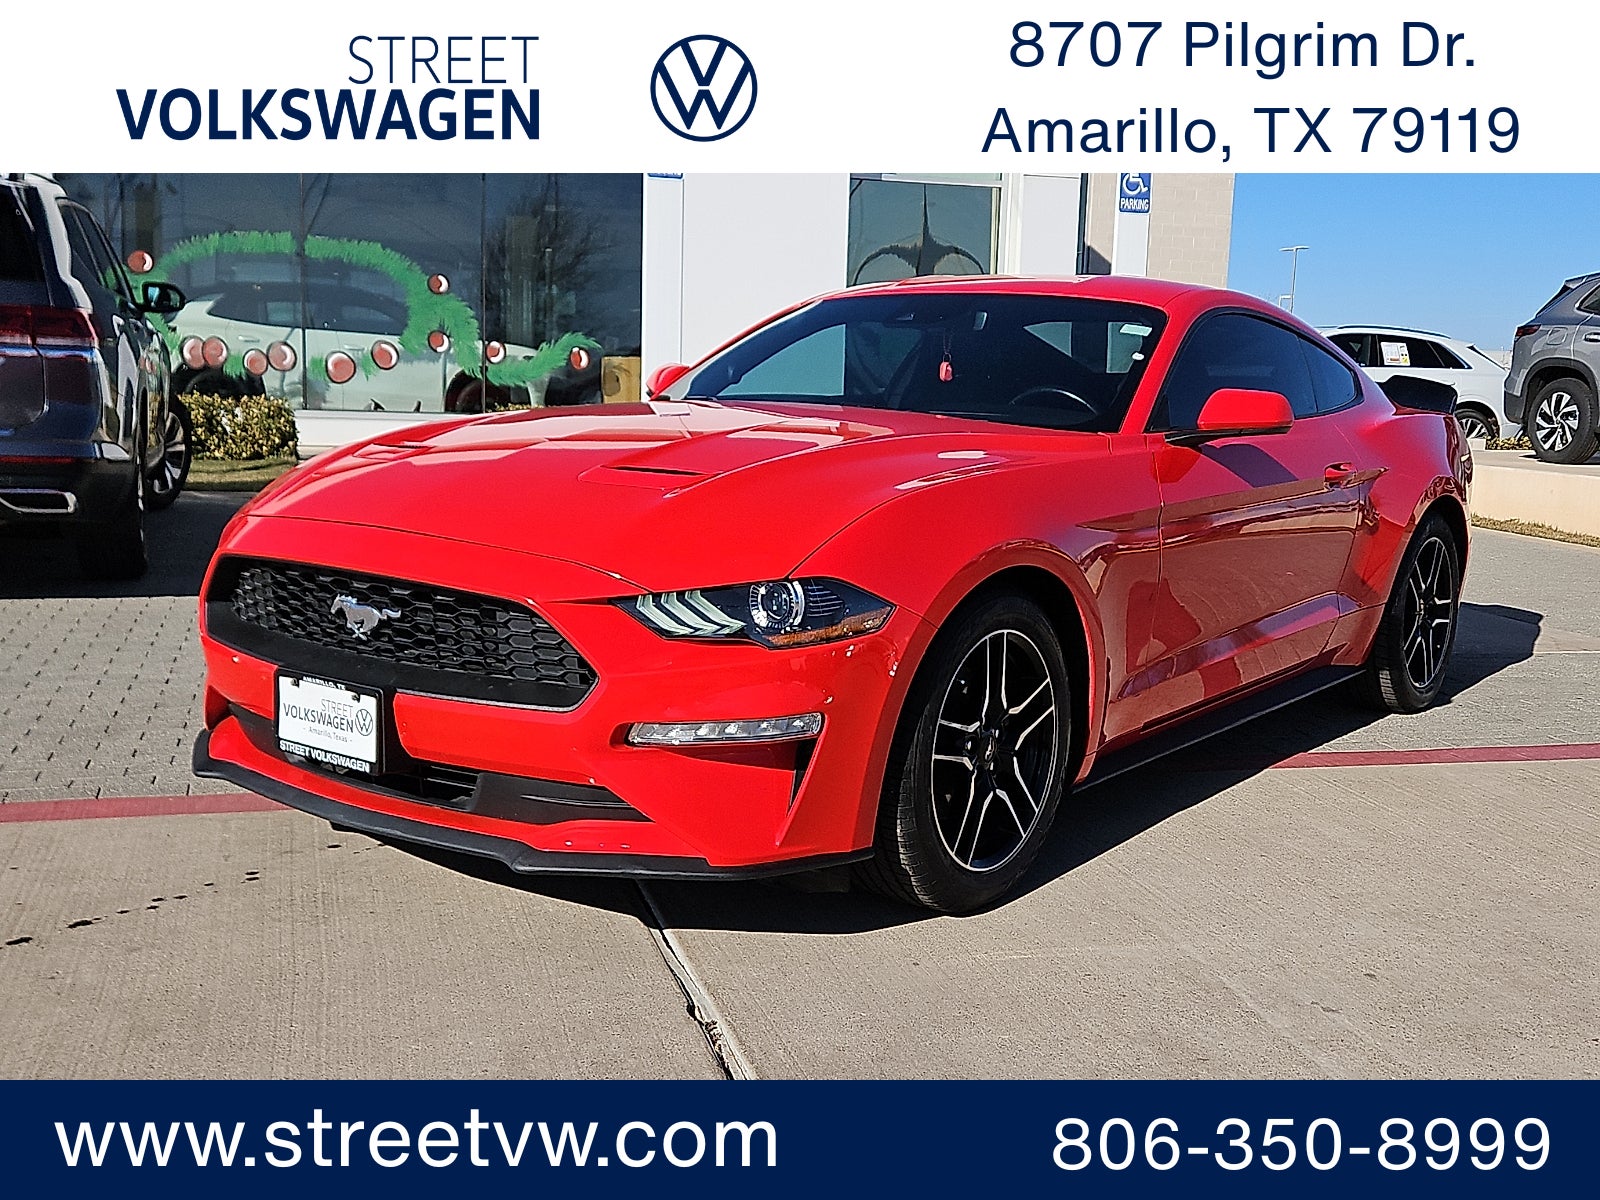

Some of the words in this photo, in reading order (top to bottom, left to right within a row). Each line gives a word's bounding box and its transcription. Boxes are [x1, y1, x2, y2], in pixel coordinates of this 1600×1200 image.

[1120, 198, 1149, 210] PARKING
[283, 703, 354, 733] VOLKSWAGEN
[320, 698, 354, 718] STREET
[280, 740, 310, 757] STREET
[310, 747, 370, 774] VOLKSWAGEN
